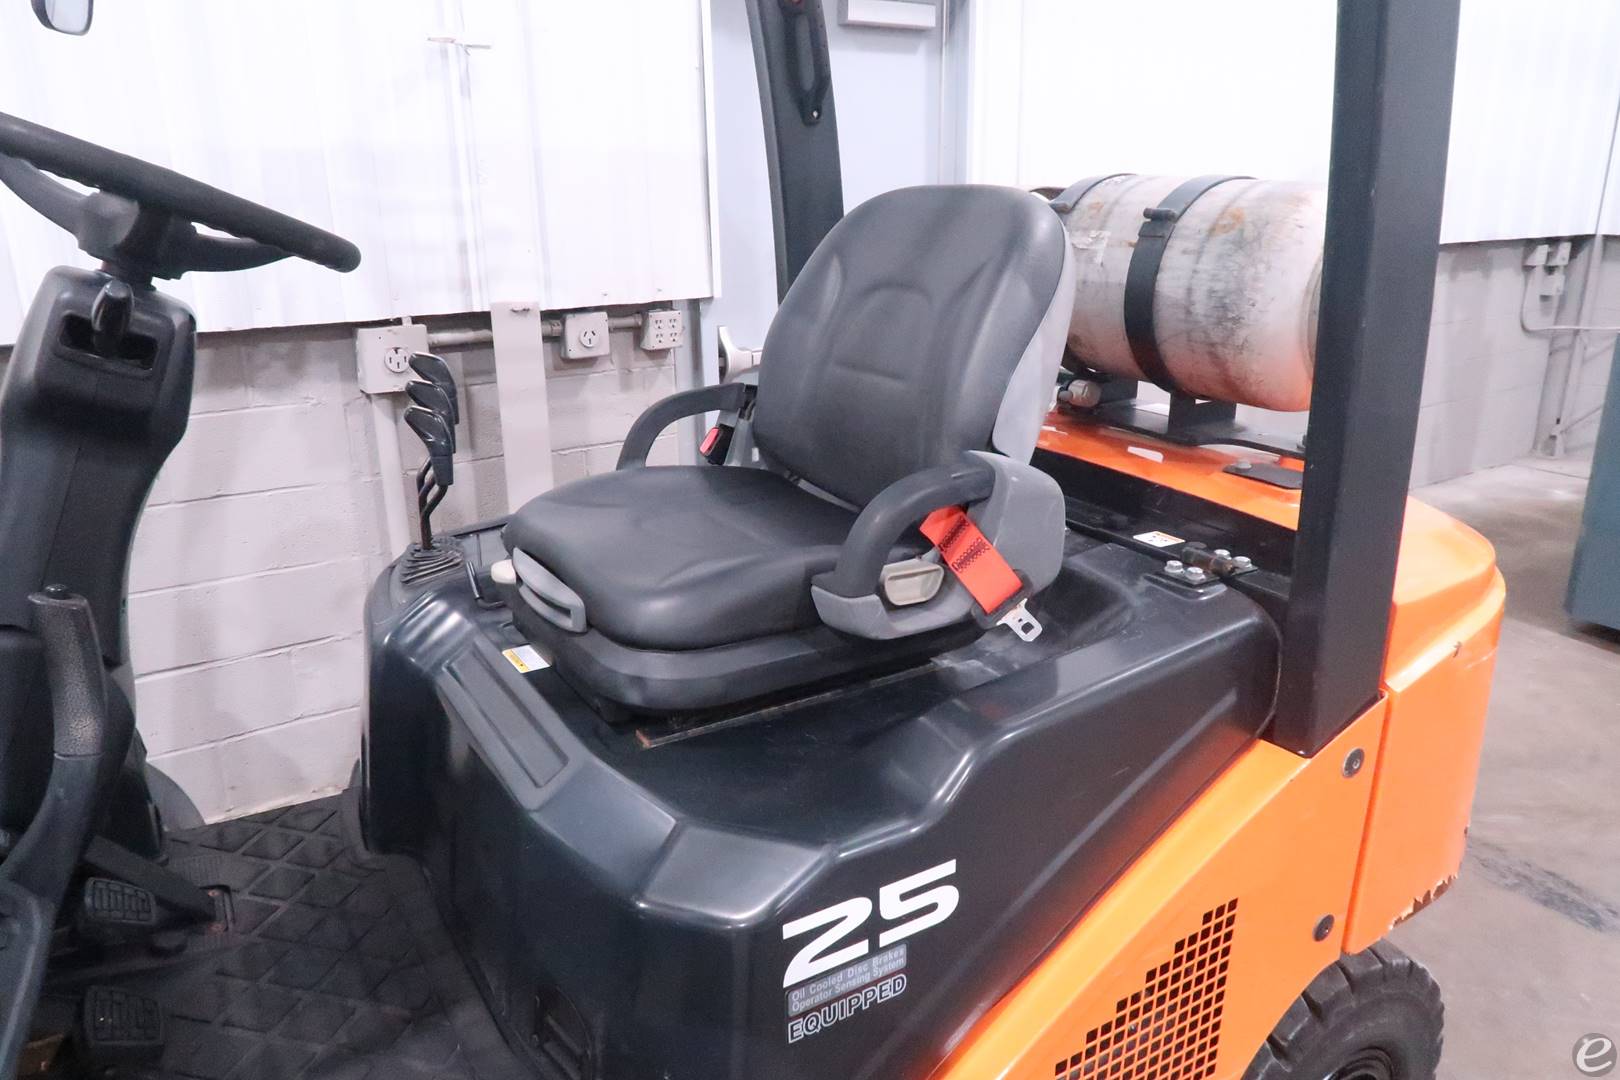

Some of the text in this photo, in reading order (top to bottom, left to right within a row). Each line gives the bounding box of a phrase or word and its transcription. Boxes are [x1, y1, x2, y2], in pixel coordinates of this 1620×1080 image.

[783, 859, 959, 988] 25
[792, 949, 905, 1001] Oil Cooled Disc Brakes
[792, 959, 905, 1014] Operator Sensing System
[788, 974, 907, 1044] EQUIPPED
